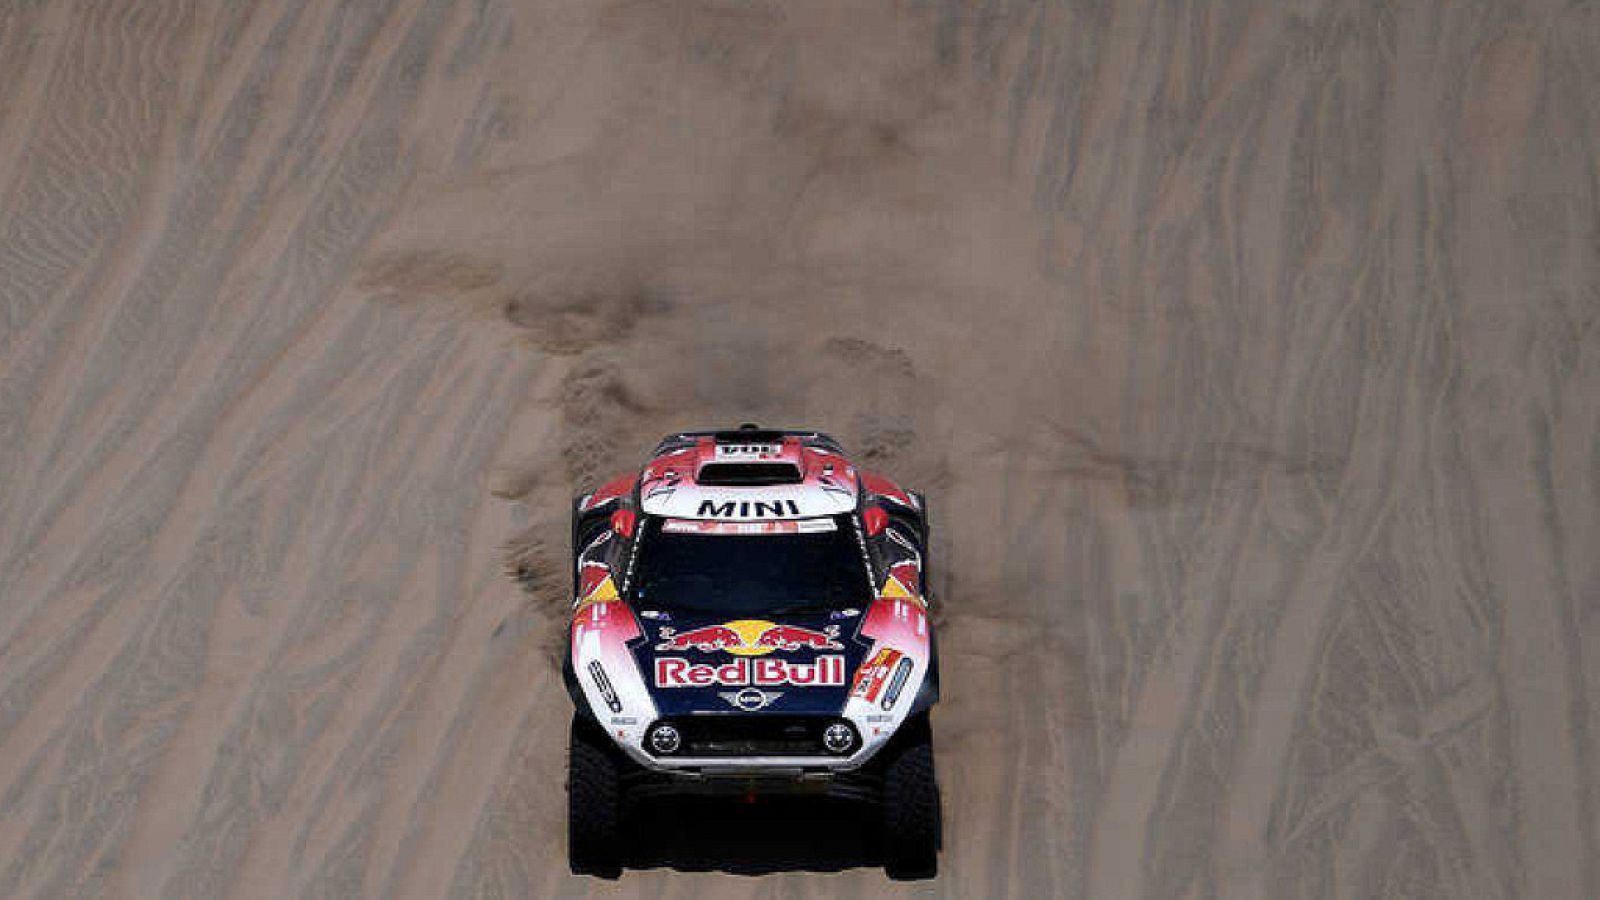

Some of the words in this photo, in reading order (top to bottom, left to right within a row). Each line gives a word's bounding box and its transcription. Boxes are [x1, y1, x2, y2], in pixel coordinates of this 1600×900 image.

[697, 499, 801, 517] MINI
[656, 657, 749, 687] Red
[753, 655, 846, 687] Bull
